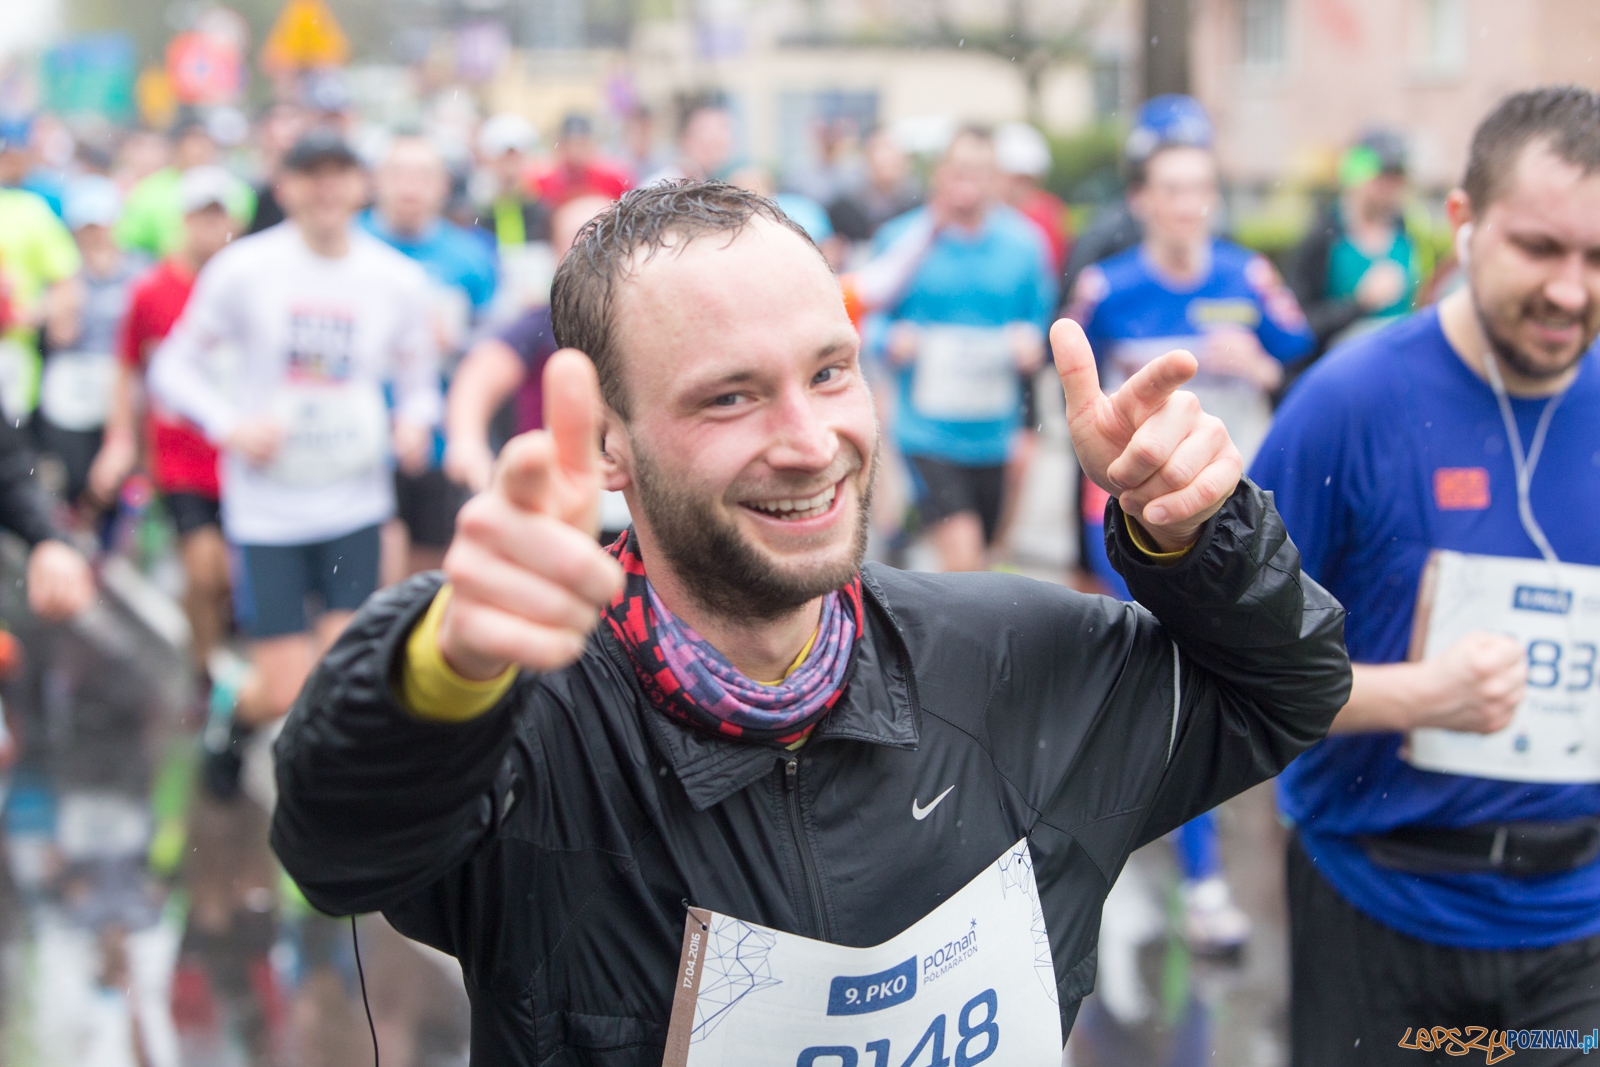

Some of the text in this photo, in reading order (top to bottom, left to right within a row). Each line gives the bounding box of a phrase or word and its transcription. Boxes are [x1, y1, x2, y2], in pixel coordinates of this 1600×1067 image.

[683, 932, 701, 989] 17.04.2016
[845, 975, 907, 1005] 9. PKO
